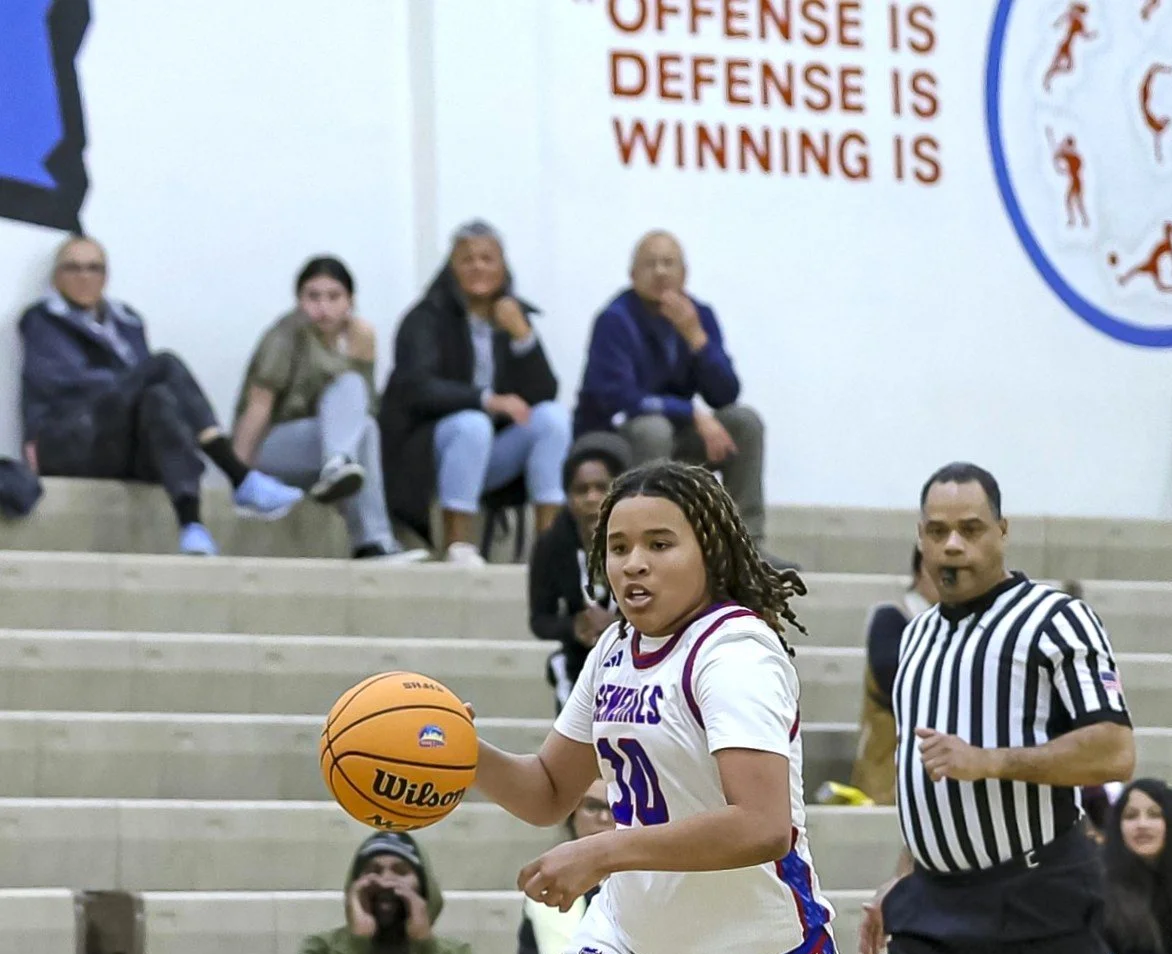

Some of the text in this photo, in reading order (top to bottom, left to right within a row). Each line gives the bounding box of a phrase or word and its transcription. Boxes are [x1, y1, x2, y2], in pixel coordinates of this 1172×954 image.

[607, 0, 937, 54] OFFENSE IS
[609, 50, 939, 118] DEFENSE IS
[612, 117, 942, 185] WINNING IS
[372, 767, 466, 808] Wilson
